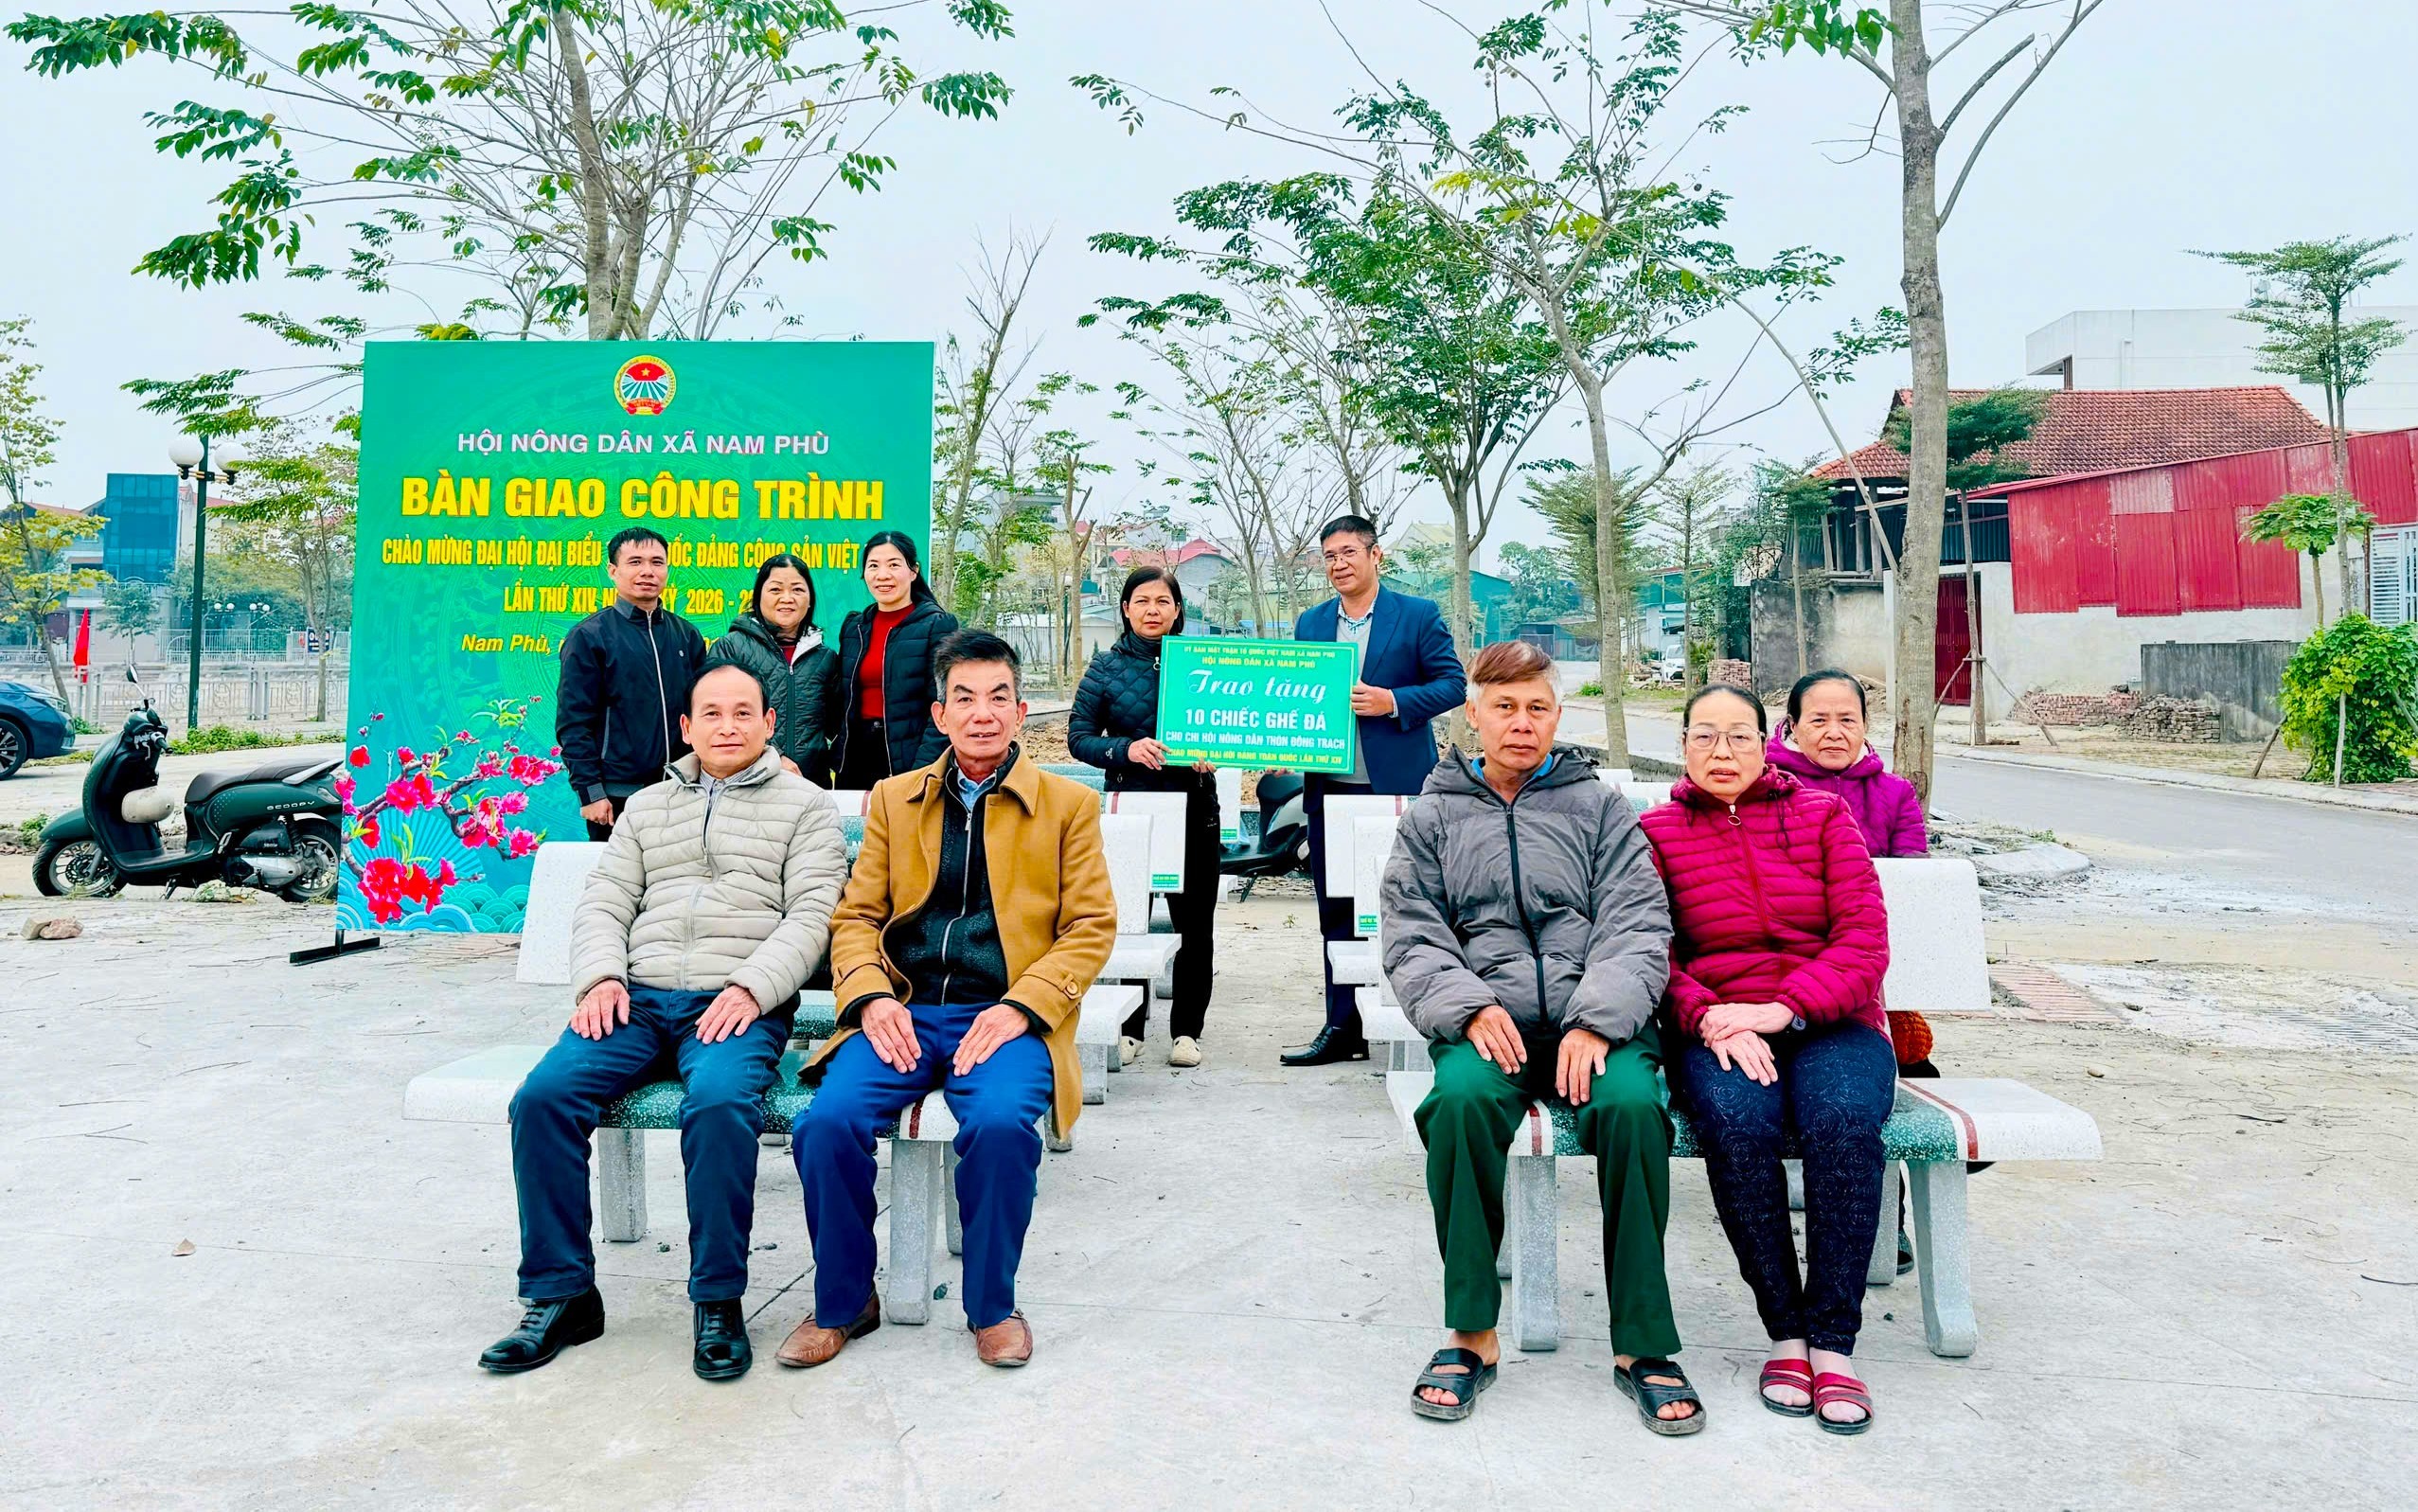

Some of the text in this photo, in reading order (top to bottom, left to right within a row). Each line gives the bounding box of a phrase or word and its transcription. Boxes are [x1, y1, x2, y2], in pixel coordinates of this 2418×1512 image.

[458, 429, 829, 455] HỘI NÔNG DÂN XÃ NAM PHÙ
[401, 469, 883, 520] BÀN GIAO CÔNG TRÌNH
[382, 534, 422, 564] CHÀO
[426, 534, 472, 565] MỪNG
[476, 540, 503, 570] ĐẠI
[507, 535, 532, 571] HỘI
[537, 541, 562, 571] ĐẠI
[566, 531, 601, 566] BIỂU
[696, 535, 739, 567] ĐẢNG
[827, 538, 860, 574] VIỆT
[504, 578, 534, 612] LẦN
[538, 582, 569, 612] THỨ
[685, 588, 723, 614] 2026
[461, 634, 504, 651] Nam
[509, 633, 551, 656] Phù,
[1202, 655, 1216, 666] HỘI
[1186, 668, 1326, 704] Trao tặng
[1185, 705, 1326, 731] 10 CHIẾC GHẾ ĐÁ
[1165, 730, 1182, 742] CHO
[1185, 732, 1200, 743] CHI
[1201, 731, 1217, 744] HỘI
[1218, 732, 1243, 745] NÔNG
[1245, 733, 1264, 746] DÂN
